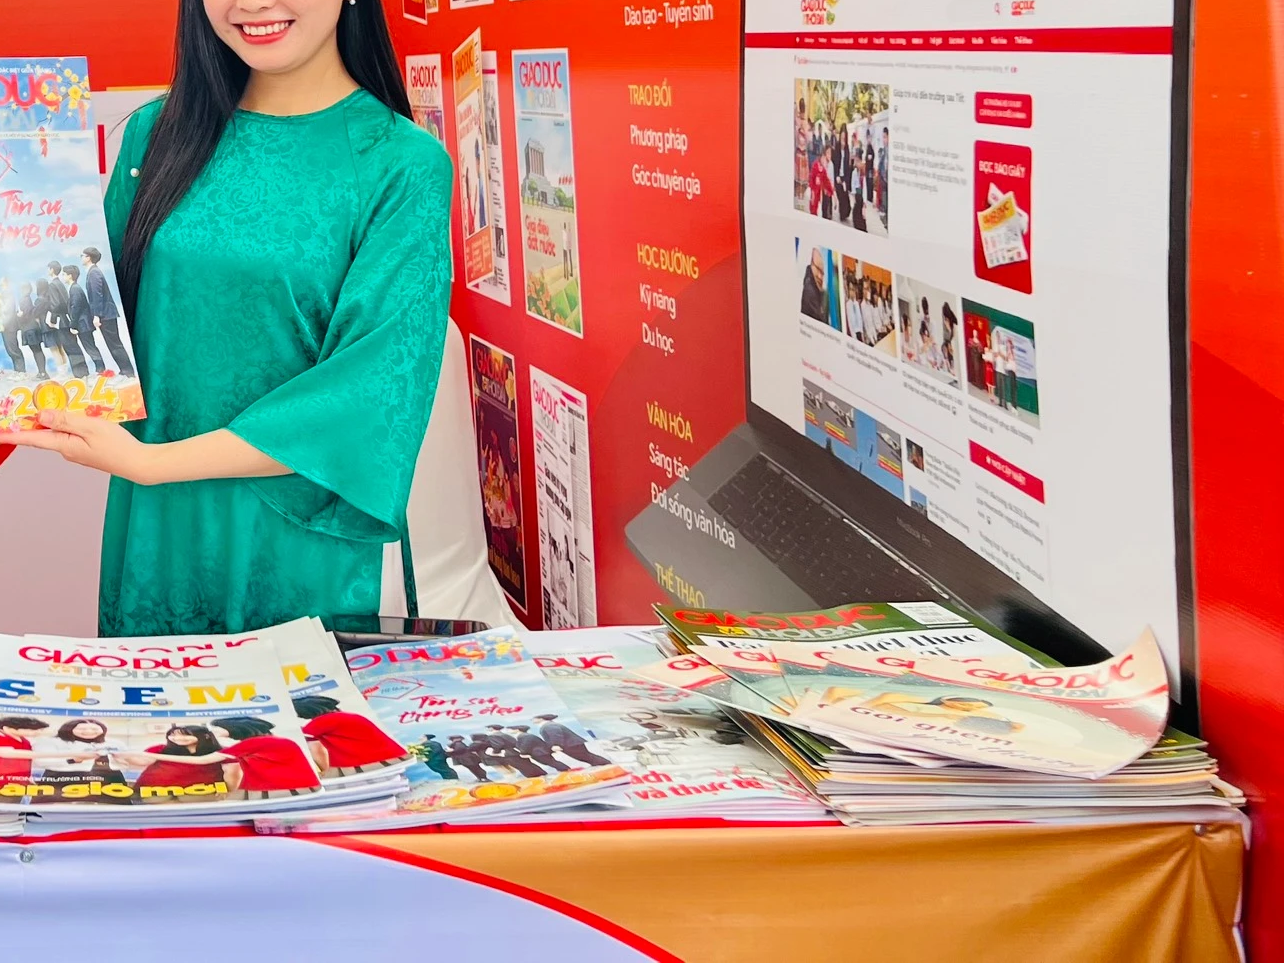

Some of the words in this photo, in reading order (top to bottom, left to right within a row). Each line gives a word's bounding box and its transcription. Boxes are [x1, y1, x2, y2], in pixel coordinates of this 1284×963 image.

[628, 85, 652, 106] TRAO
[653, 78, 671, 107] ĐỔI
[630, 124, 662, 153] Phương
[664, 128, 687, 156] pháp
[632, 164, 651, 186] Góc
[651, 167, 685, 196] chuyên
[686, 172, 700, 199] gia
[637, 243, 658, 270] HỌC
[660, 247, 699, 279] ĐƯỜNG
[642, 322, 655, 347] Du
[656, 327, 674, 356] học
[646, 401, 667, 433] VĂN
[669, 412, 693, 443] HÓA
[649, 442, 672, 478] Sáng
[673, 457, 690, 481] tác
[651, 482, 667, 510] Đời
[668, 492, 693, 530] sống
[694, 509, 713, 536] văn
[714, 520, 735, 549] hóa
